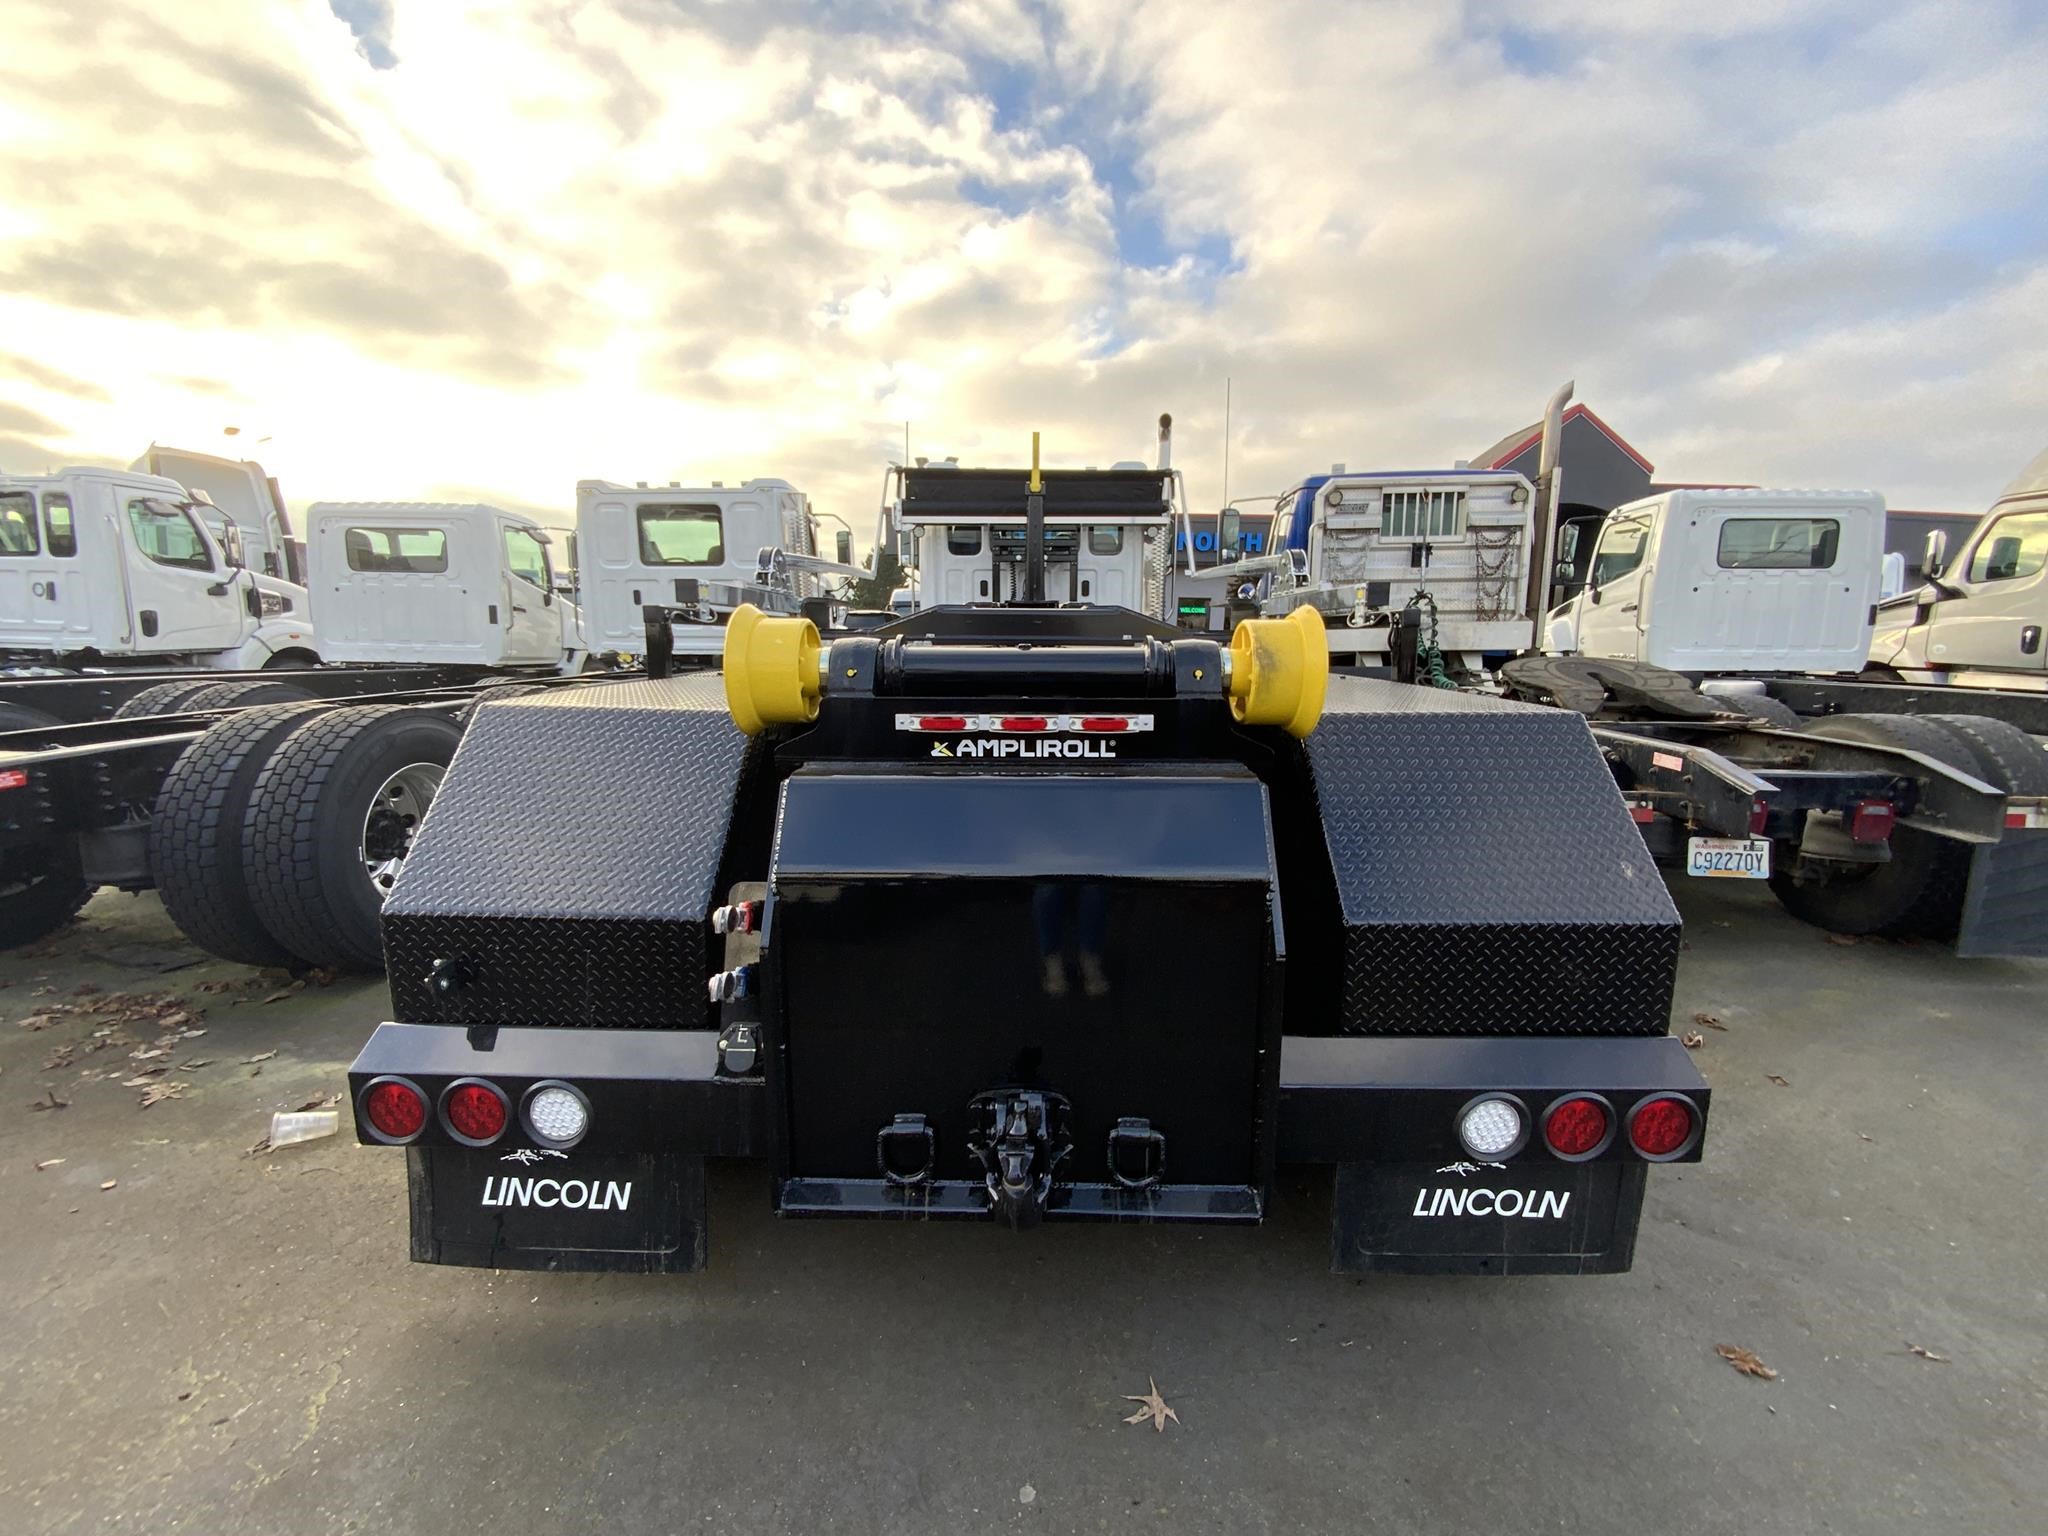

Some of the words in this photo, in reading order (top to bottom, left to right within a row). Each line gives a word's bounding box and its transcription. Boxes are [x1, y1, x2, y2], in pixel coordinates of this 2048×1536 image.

[1177, 532, 1263, 552] NOH
[1180, 606, 1206, 614] WELCOME
[1695, 843, 1739, 851] WASHINGTON
[1694, 852, 1764, 872] C92270Y
[481, 1176, 632, 1211] LINCOLN
[1412, 1188, 1571, 1219] LINCOLN
